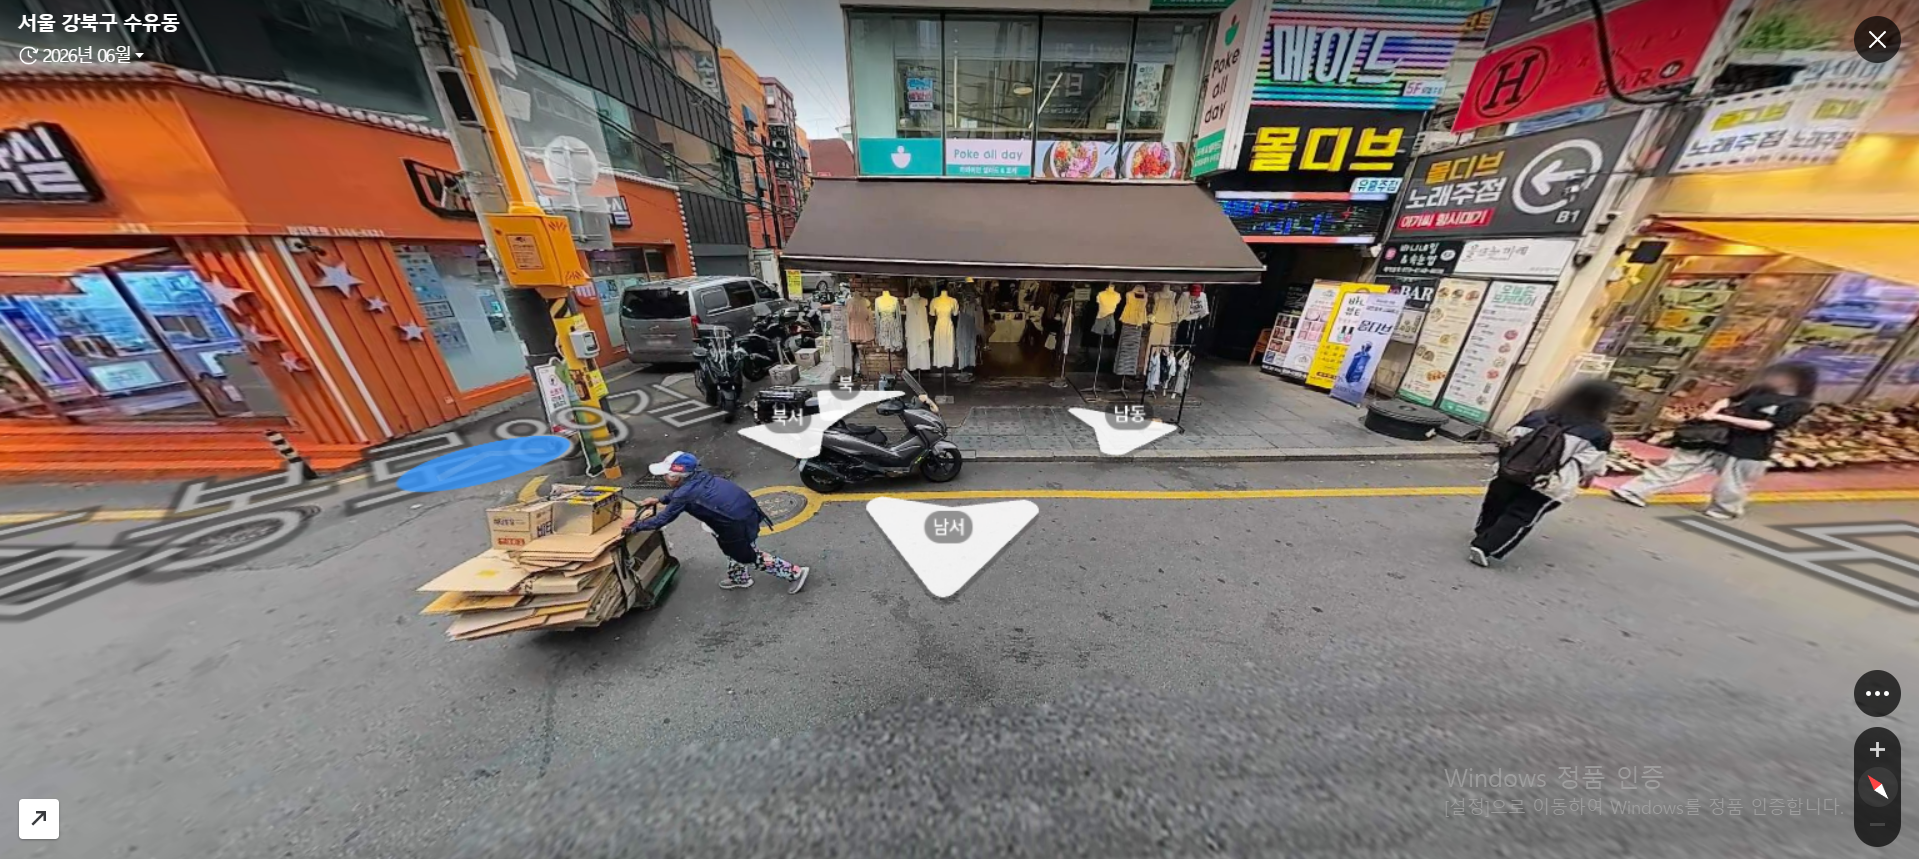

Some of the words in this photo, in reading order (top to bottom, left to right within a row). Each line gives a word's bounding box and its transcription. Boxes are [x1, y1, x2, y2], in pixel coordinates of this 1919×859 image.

[1211, 48, 1240, 78] Poke
[1272, 24, 1404, 84] 메이드
[1212, 74, 1229, 98] all
[1482, 53, 1541, 111] H
[1593, 69, 1652, 96] BAR
[1204, 101, 1227, 123] day
[954, 149, 979, 159] Poke
[984, 149, 997, 159] all
[1001, 149, 1023, 161] day
[1250, 127, 1404, 172] 몰디브
[1687, 130, 1787, 157] 노래주점
[1425, 151, 1505, 184] 몰디브
[1356, 179, 1399, 192] 유흥주점
[1405, 178, 1504, 209] 노래주점
[1401, 213, 1433, 228] 아가씨
[1435, 209, 1487, 227] 항시대기
[1555, 210, 1579, 223] B1
[1401, 285, 1434, 302] BAR
[1357, 320, 1394, 335] 몰디브
